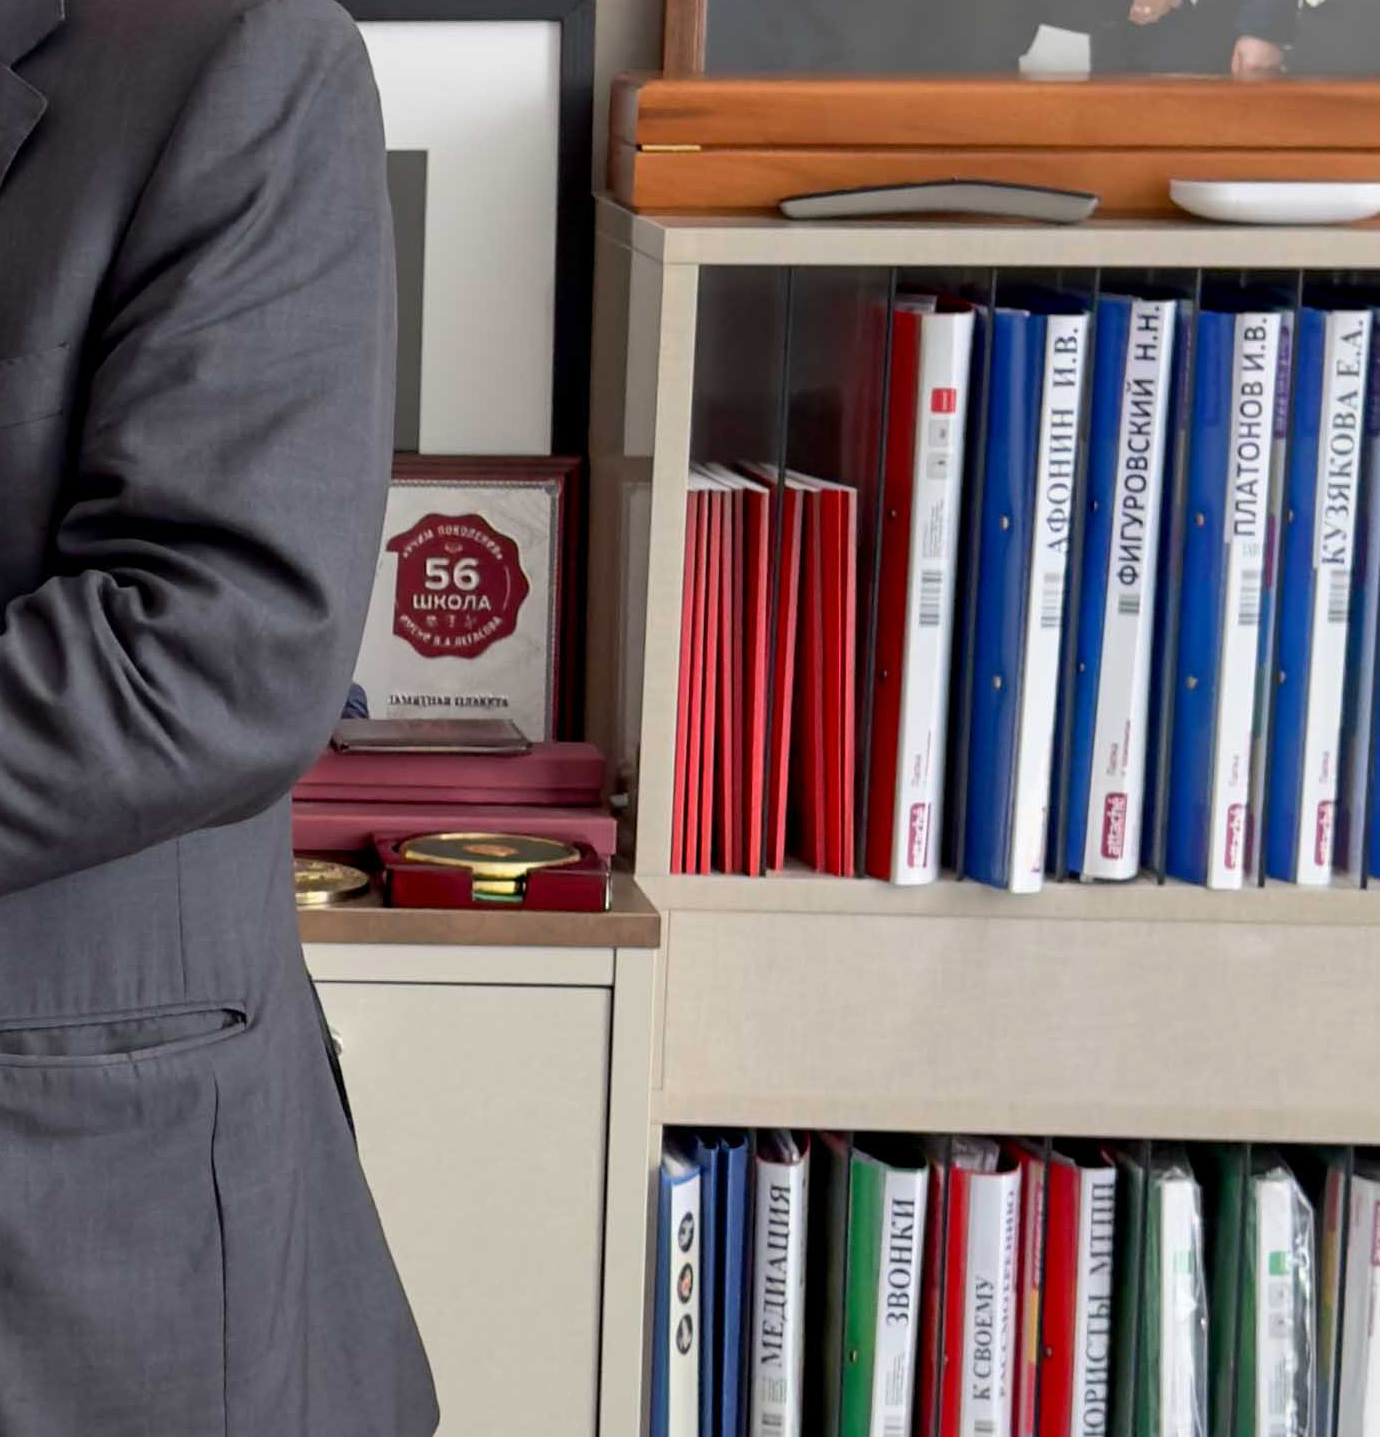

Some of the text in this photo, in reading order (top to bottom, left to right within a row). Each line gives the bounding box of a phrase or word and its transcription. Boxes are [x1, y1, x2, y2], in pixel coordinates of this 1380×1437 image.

[1046, 327, 1080, 554] АФОНИН И.В.
[1116, 305, 1160, 587] ФИГУРОВСКИЙ Н.Н.
[1233, 317, 1268, 537] ПЛАТОНОВ И.В.
[1321, 320, 1364, 565] КУЗЯКОВА Е.А.
[413, 594, 492, 610] ШКОЛА
[425, 557, 480, 591] 56
[761, 1184, 791, 1368] МЕДИАЦИЯ
[886, 1198, 916, 1328] ЗВОНКИ
[973, 1276, 995, 1401] К СВОЕМУ
[1083, 1182, 1116, 1437] ЮРИСТЫ МТПП
